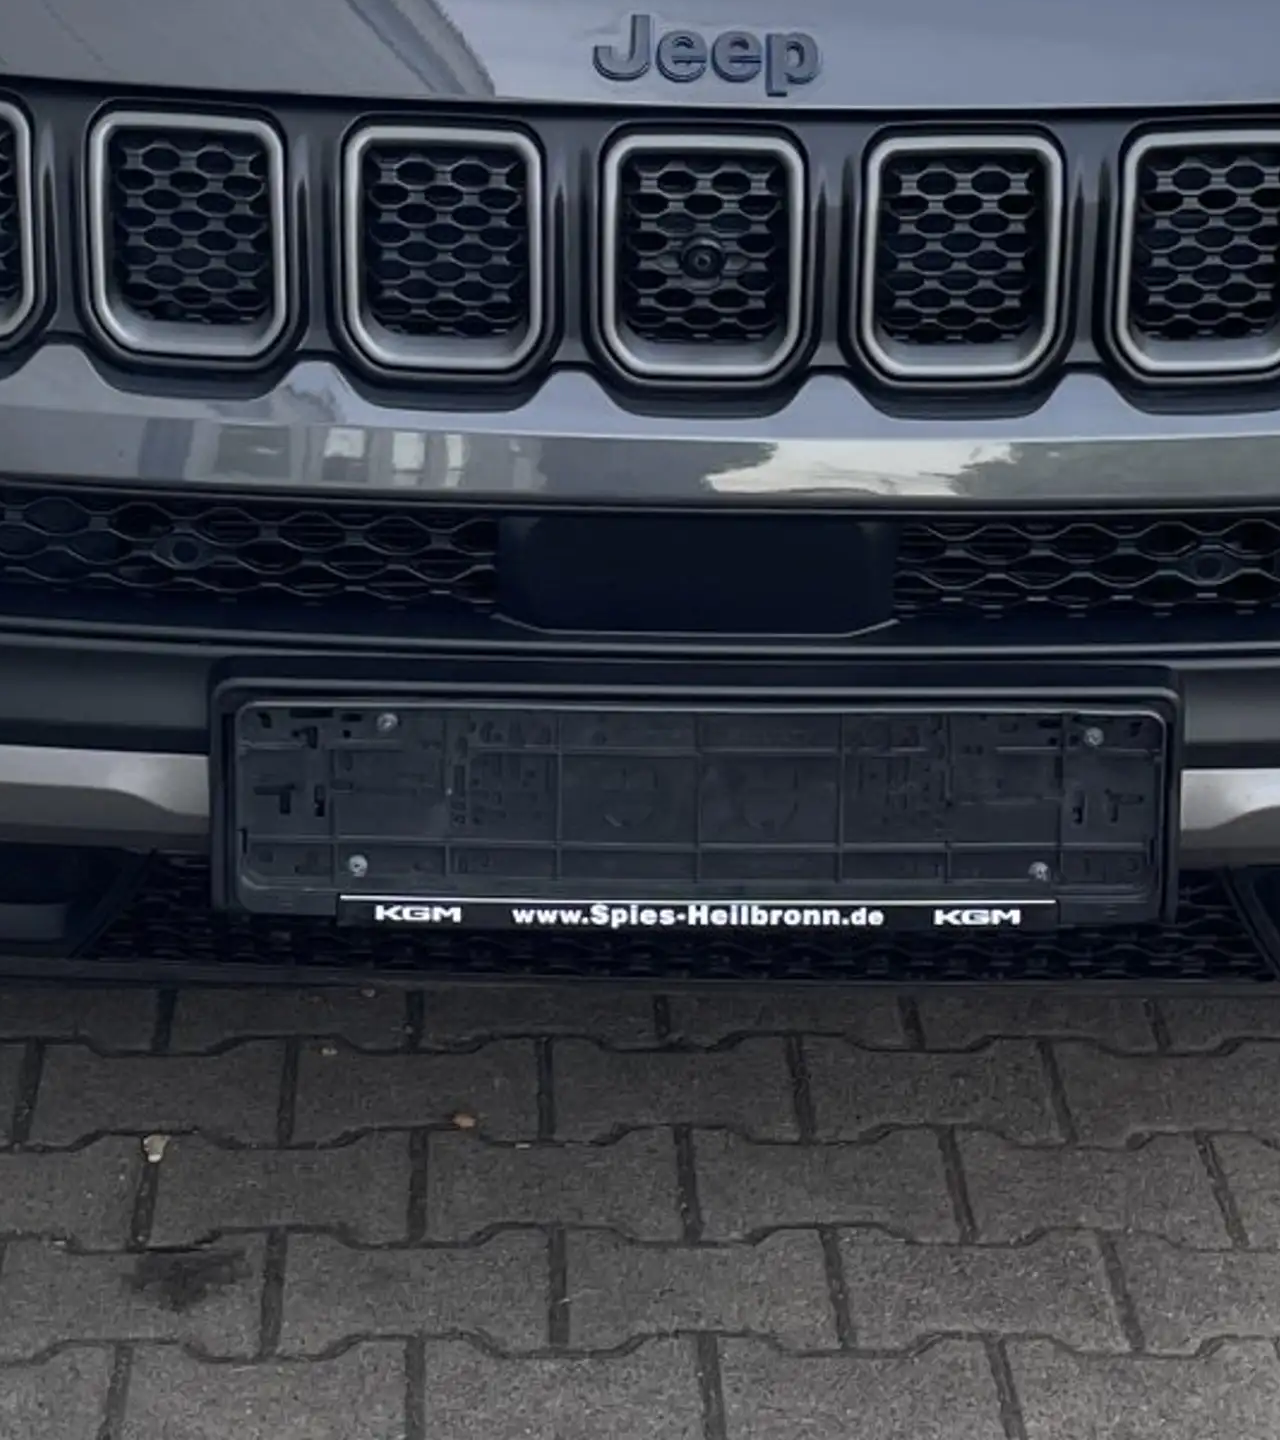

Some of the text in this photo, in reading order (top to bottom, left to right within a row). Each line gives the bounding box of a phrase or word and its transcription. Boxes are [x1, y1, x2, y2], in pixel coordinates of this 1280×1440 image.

[592, 14, 822, 98] Jeep
[375, 902, 1022, 928] KGM www.Spies-Heilbronn.de KGM
